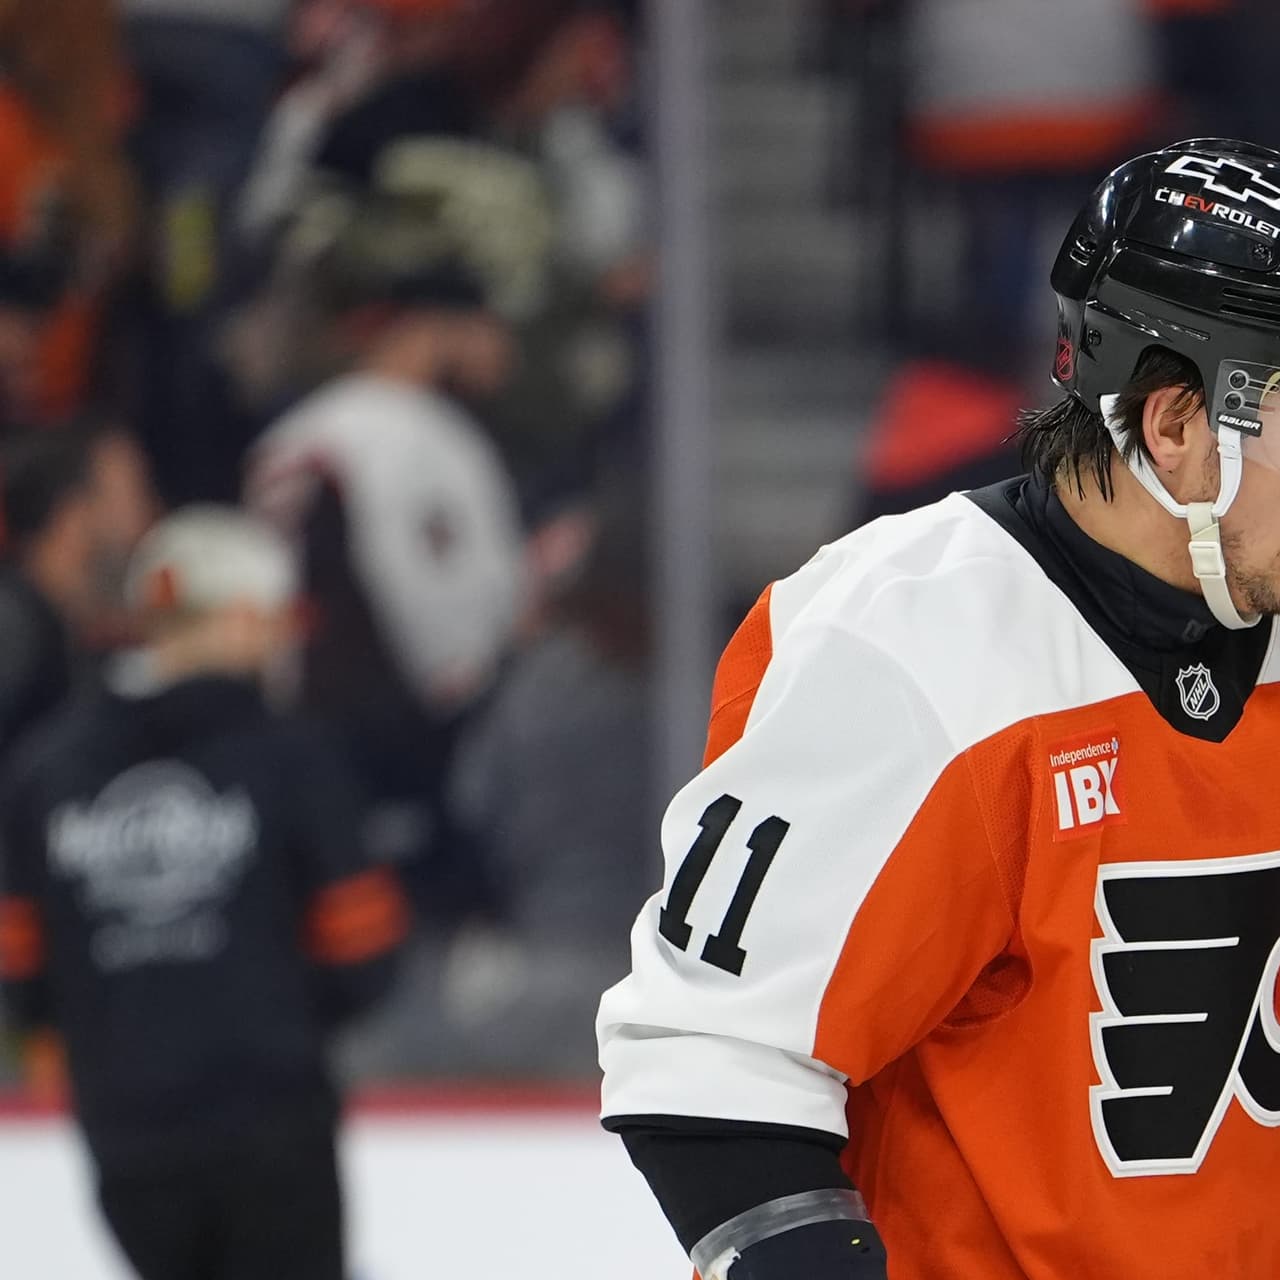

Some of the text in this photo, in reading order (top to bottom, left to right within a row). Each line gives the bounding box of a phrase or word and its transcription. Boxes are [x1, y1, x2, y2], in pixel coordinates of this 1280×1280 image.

[1188, 675, 1208, 711] NHL
[1049, 741, 1112, 768] Independence
[1054, 757, 1122, 831] IBX
[658, 793, 791, 977] 11
